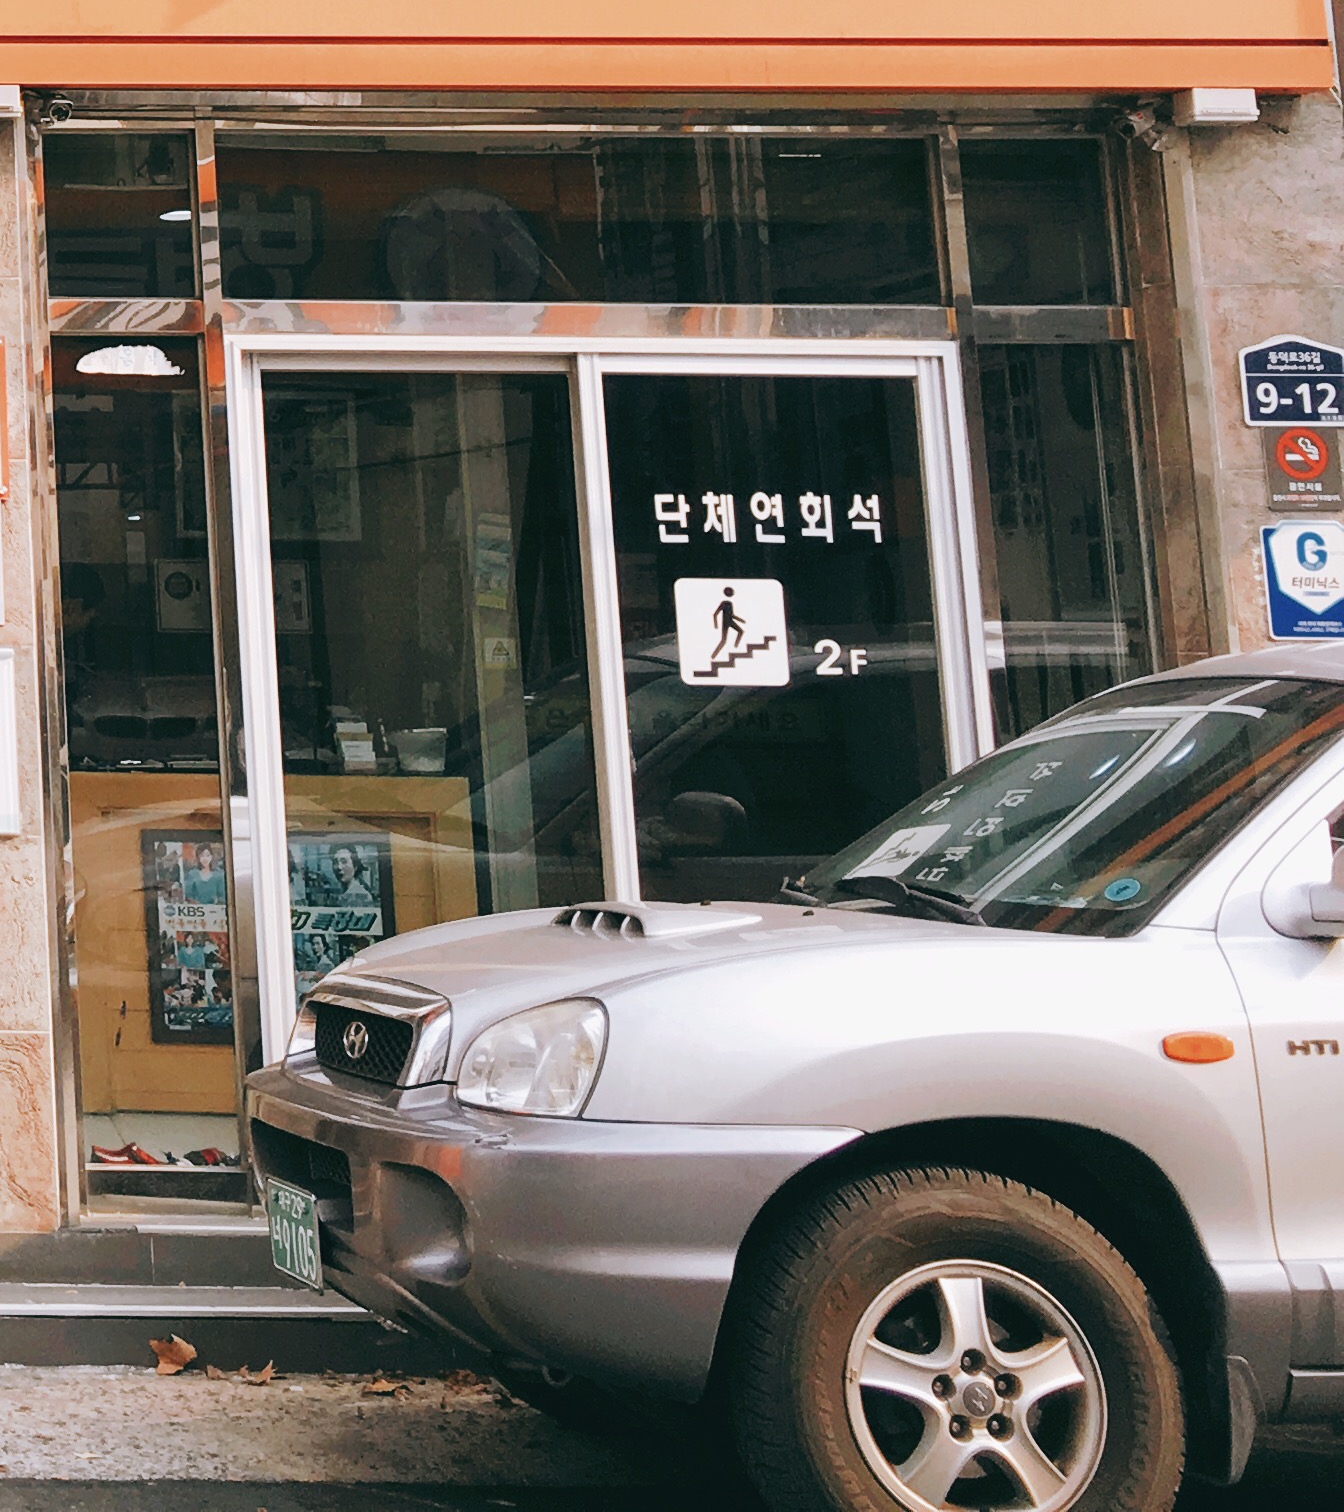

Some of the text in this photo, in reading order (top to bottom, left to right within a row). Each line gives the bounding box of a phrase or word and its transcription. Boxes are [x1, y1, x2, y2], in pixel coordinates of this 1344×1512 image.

[1255, 382, 1339, 414] 9-12
[653, 491, 882, 544] 단체연회석
[1291, 576, 1341, 589] 터미닉스
[812, 638, 869, 676] 2F
[177, 905, 206, 918] KBS
